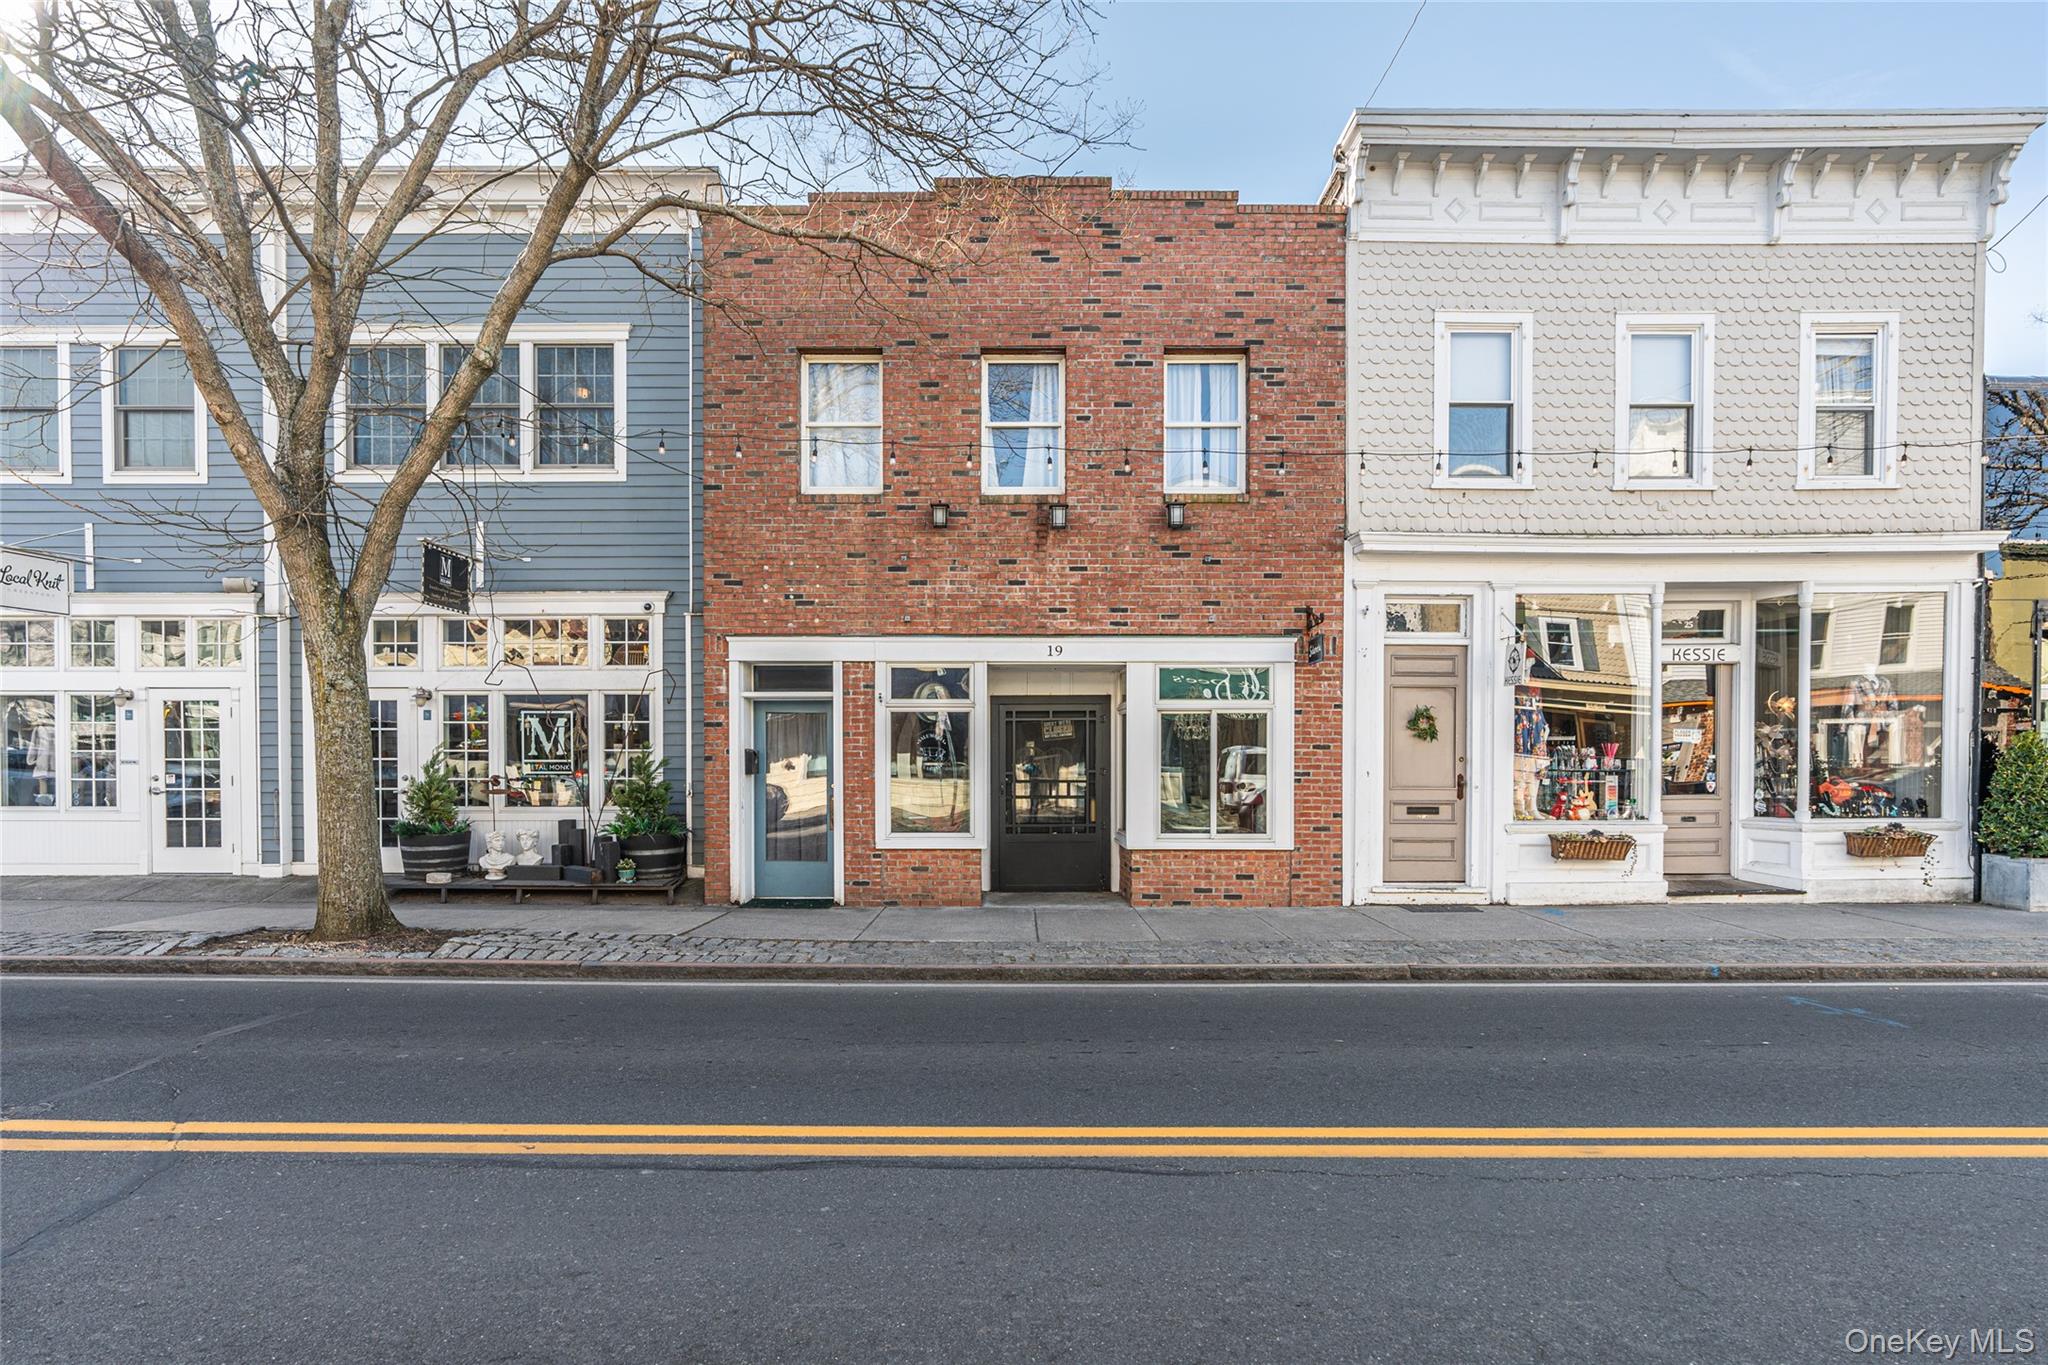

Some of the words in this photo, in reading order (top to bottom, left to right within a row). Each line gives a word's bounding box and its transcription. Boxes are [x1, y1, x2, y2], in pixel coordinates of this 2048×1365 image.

[440, 556, 452, 578] M
[0, 565, 32, 588] Local
[33, 569, 65, 592] Knit
[1683, 620, 1694, 629] 25
[1047, 644, 1063, 657] 19
[1672, 647, 1726, 661] KESSIE
[527, 717, 568, 756] M
[550, 763, 570, 771] MONK
